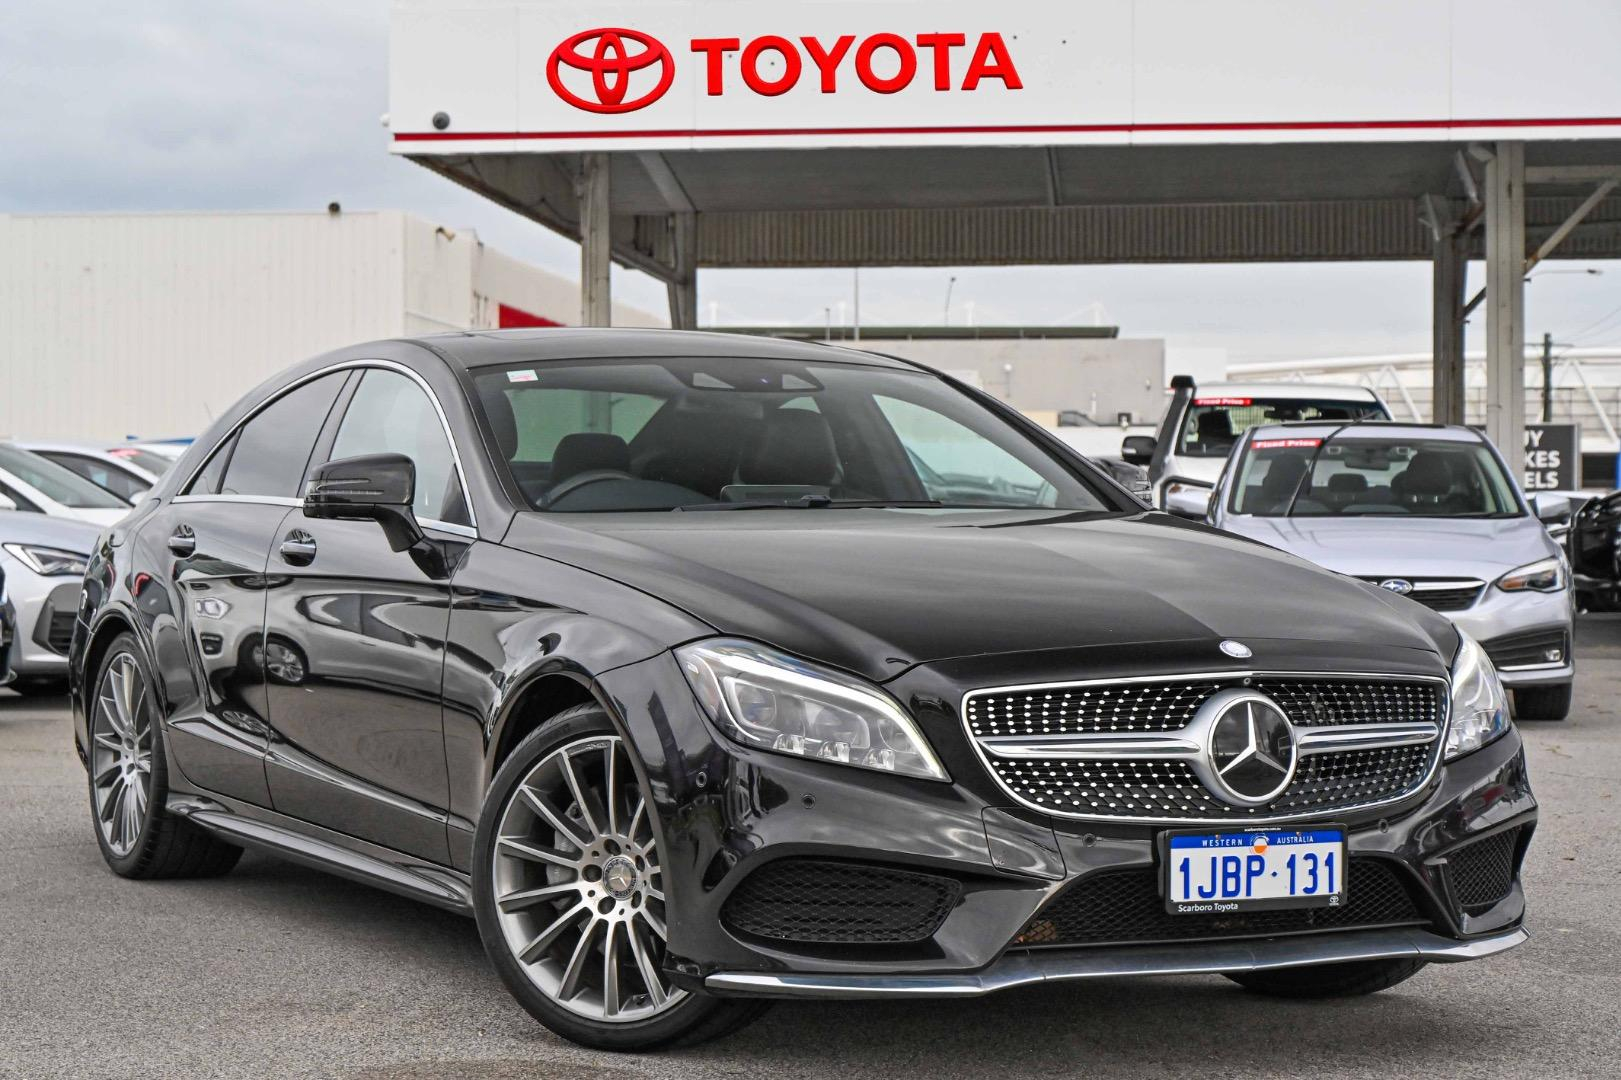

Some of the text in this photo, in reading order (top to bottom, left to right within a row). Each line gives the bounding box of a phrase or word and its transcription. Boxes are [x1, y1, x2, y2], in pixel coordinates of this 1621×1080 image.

[691, 32, 1023, 96] TOYOTA
[1202, 835, 1314, 847] WESTERN AUSTRALIA
[1178, 902, 1238, 912] Scarboro Toyota
